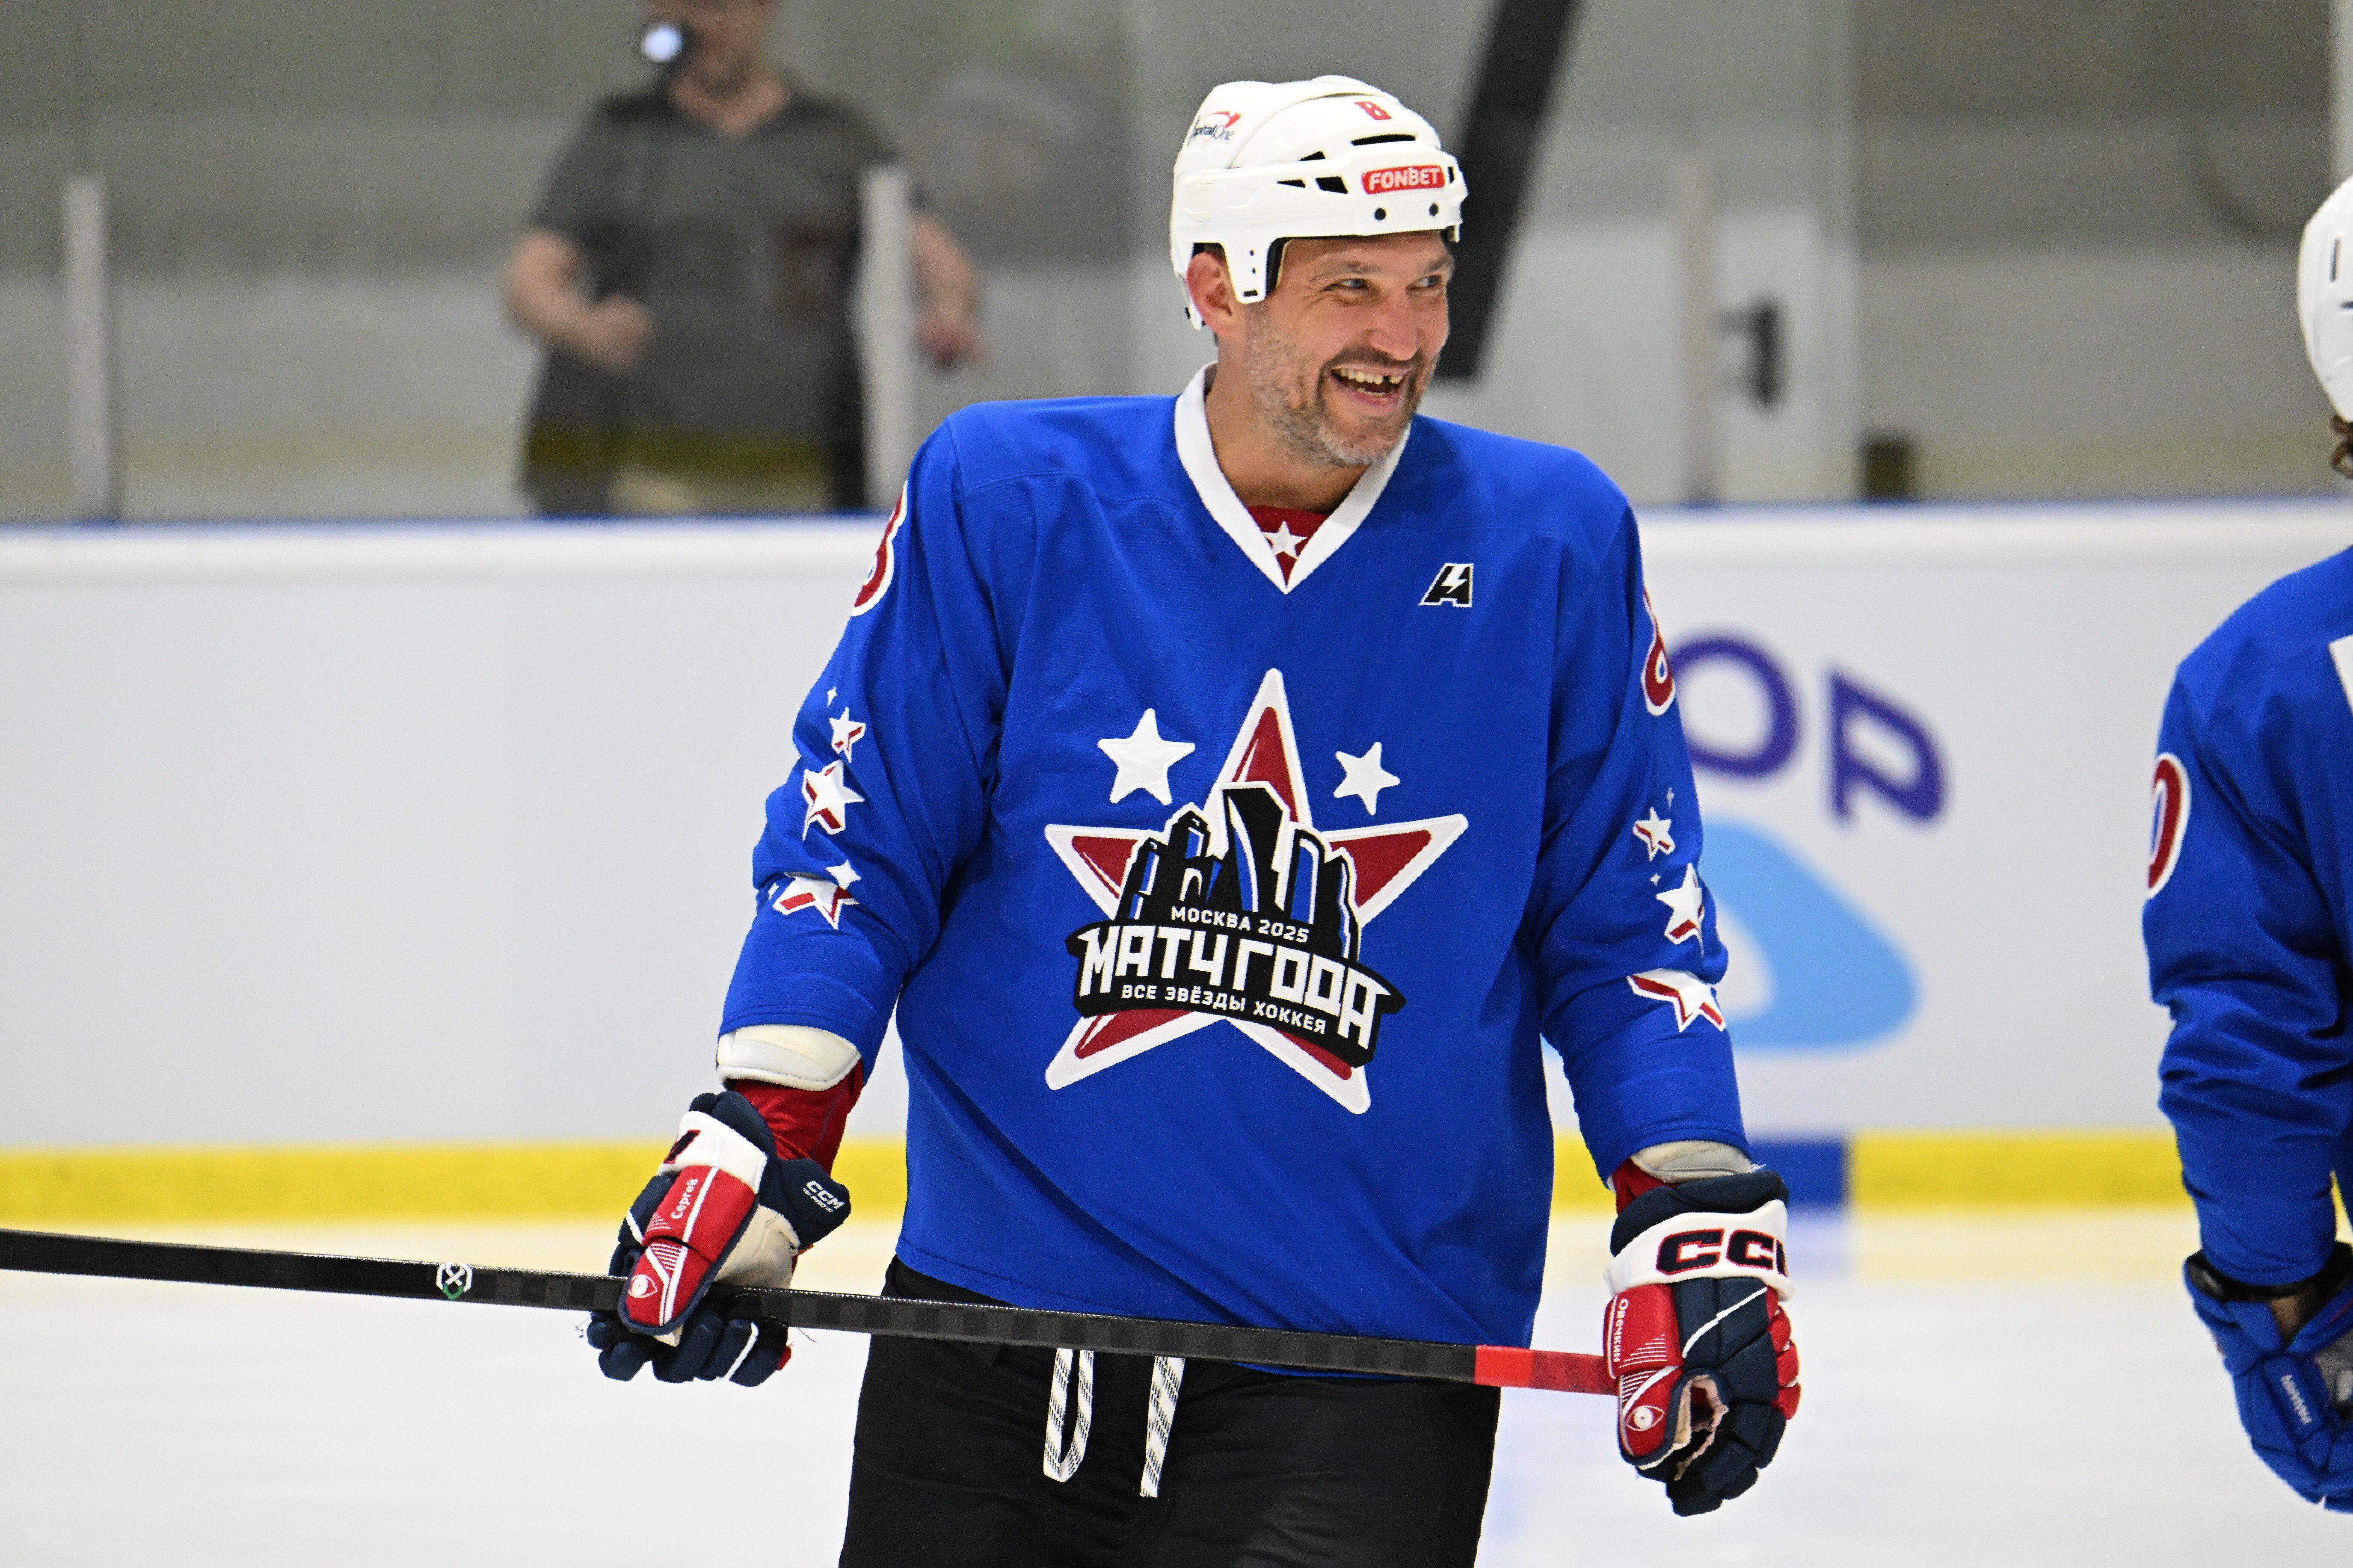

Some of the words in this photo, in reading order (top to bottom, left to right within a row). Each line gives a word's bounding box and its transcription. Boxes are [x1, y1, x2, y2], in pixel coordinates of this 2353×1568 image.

[1354, 101, 1391, 120] 8
[1369, 167, 1440, 191] FONBET
[1171, 906, 1251, 931] МОСКВА
[1258, 919, 1310, 943] 2025
[1078, 925, 1228, 997] МАТЧ
[1233, 938, 1391, 1050] ГОДА
[1122, 984, 1157, 1000] ВСЕ
[1165, 985, 1246, 1012] ЗВЁЗДЫ
[1253, 1000, 1327, 1035] ХОККЕЯ
[671, 1178, 698, 1219] Сергей
[806, 1180, 845, 1210] CCM
[1655, 1228, 1788, 1278] CC
[1612, 1299, 1629, 1362] Овечкин
